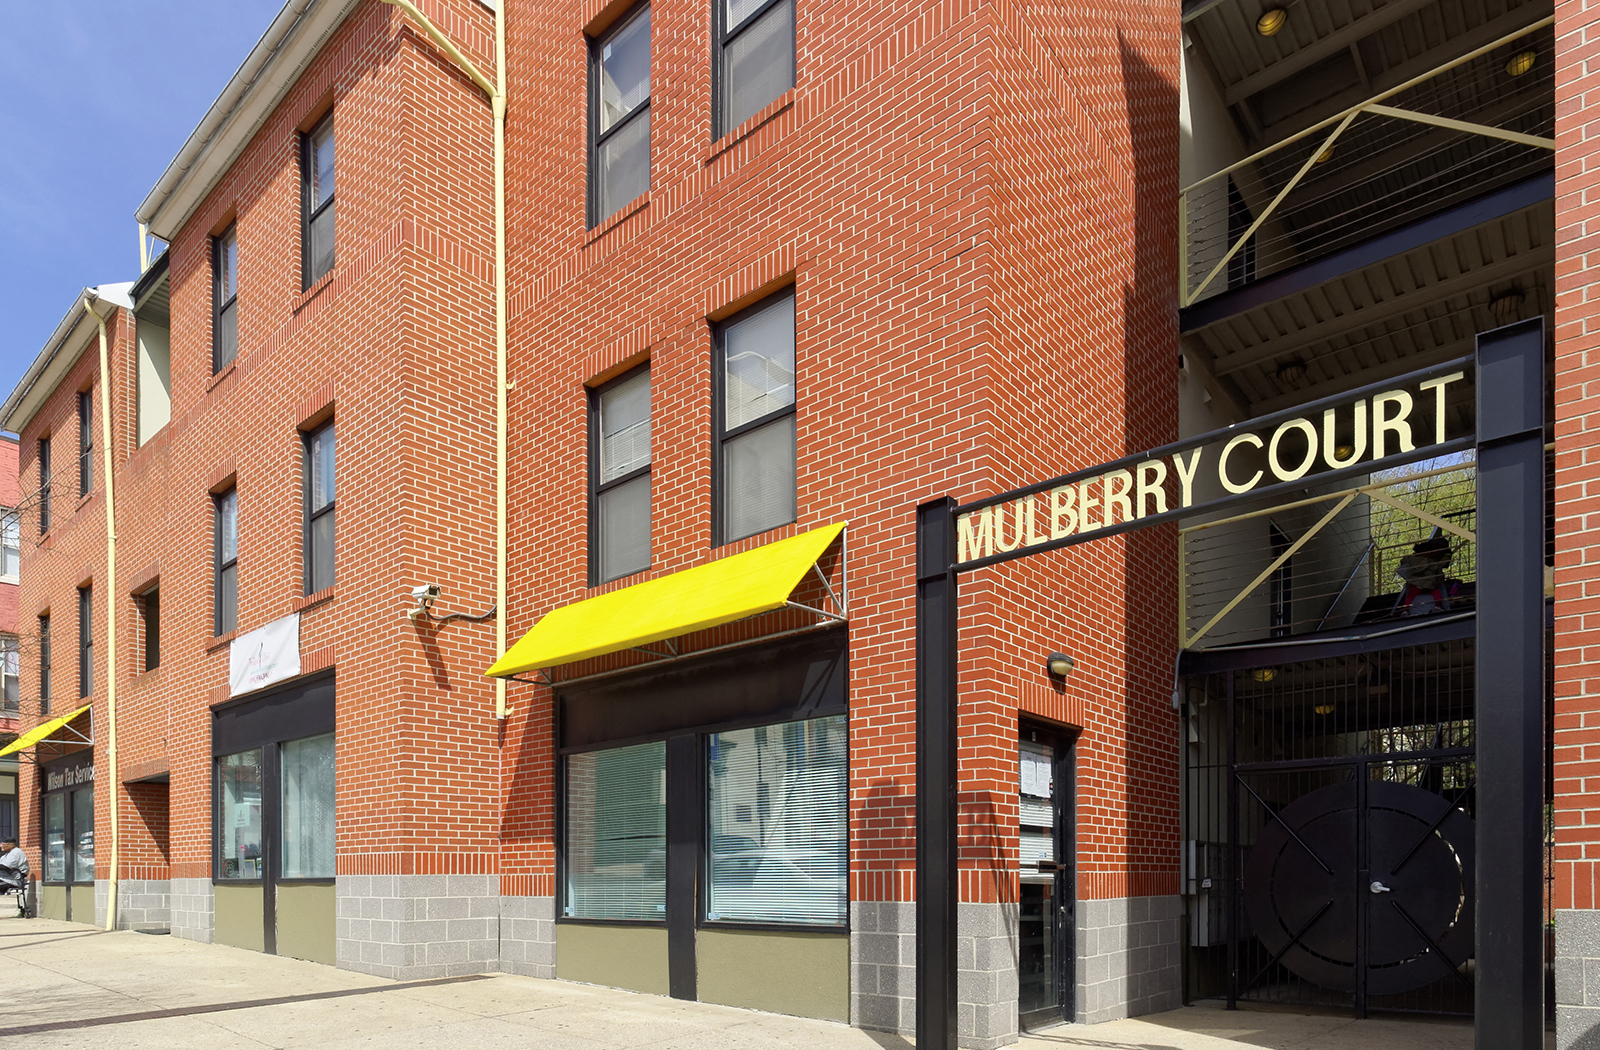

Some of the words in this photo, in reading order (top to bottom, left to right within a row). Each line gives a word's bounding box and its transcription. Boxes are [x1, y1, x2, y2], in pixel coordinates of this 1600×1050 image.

[957, 445, 1204, 564] MULBERRY
[1218, 371, 1464, 494] COURT
[47, 772, 64, 791] Wilson
[64, 767, 75, 786] Tax
